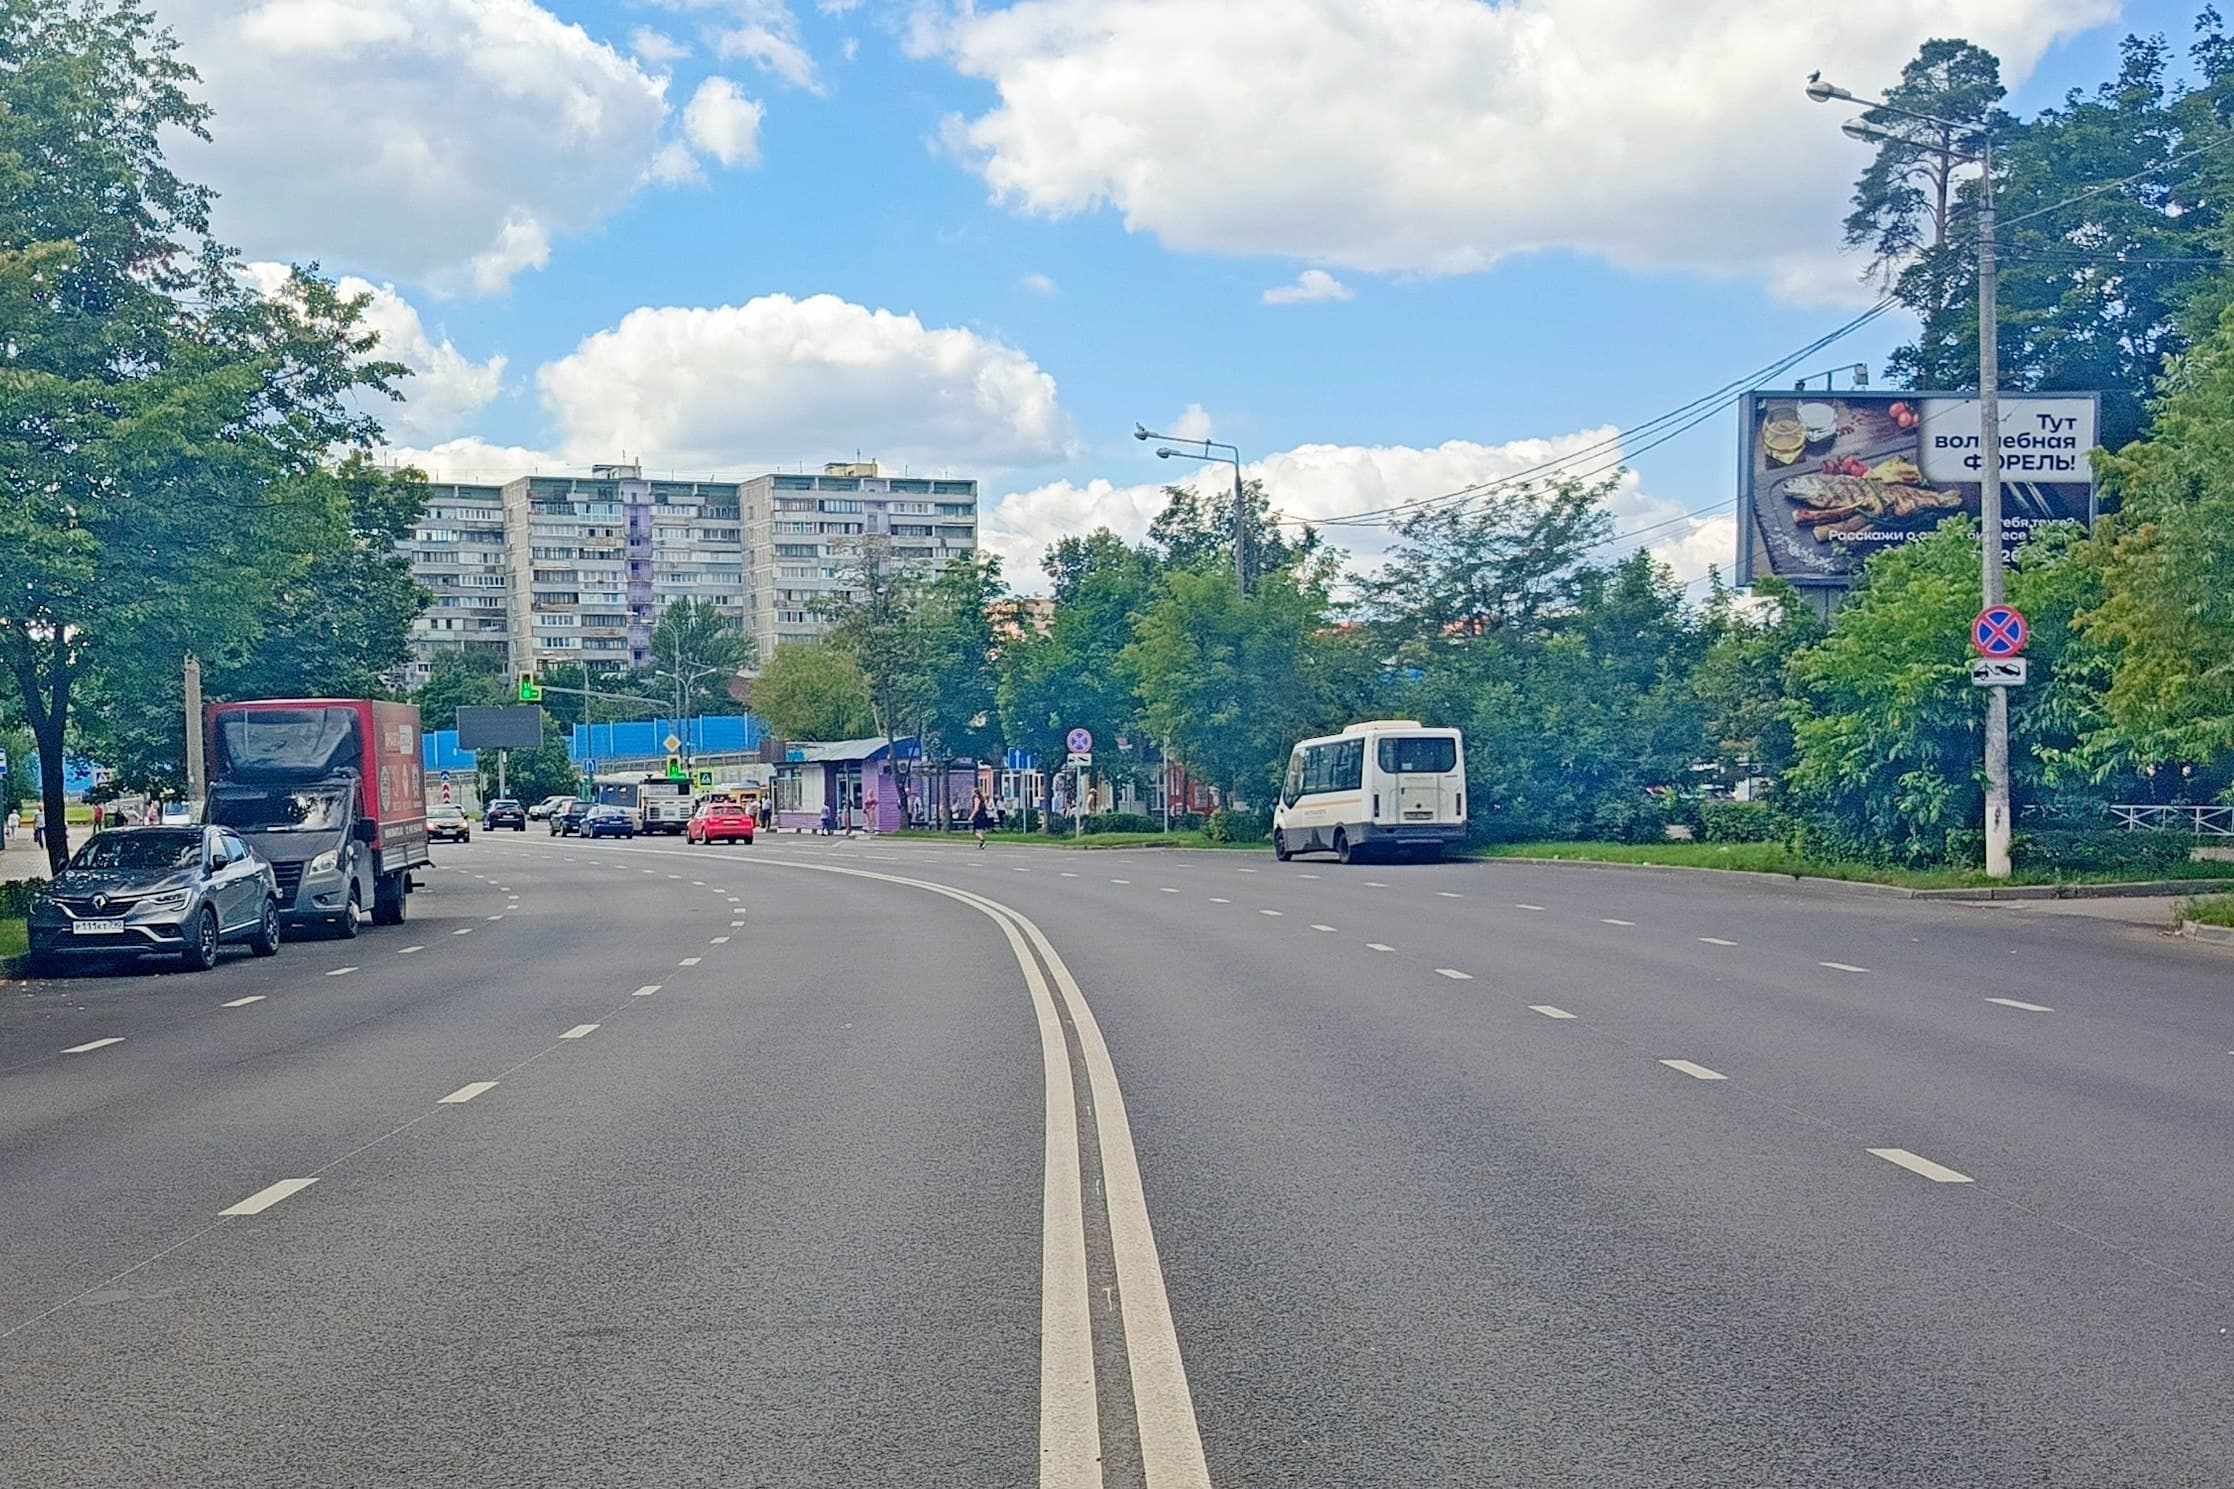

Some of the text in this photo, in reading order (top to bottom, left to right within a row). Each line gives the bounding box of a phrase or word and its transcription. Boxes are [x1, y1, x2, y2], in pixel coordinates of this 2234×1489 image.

[2036, 414, 2077, 433] Тут
[1935, 432, 2076, 449] волебная
[1999, 516, 2029, 528] ебя
[1828, 530, 1904, 541] Расскажи
[1906, 531, 1915, 541] о
